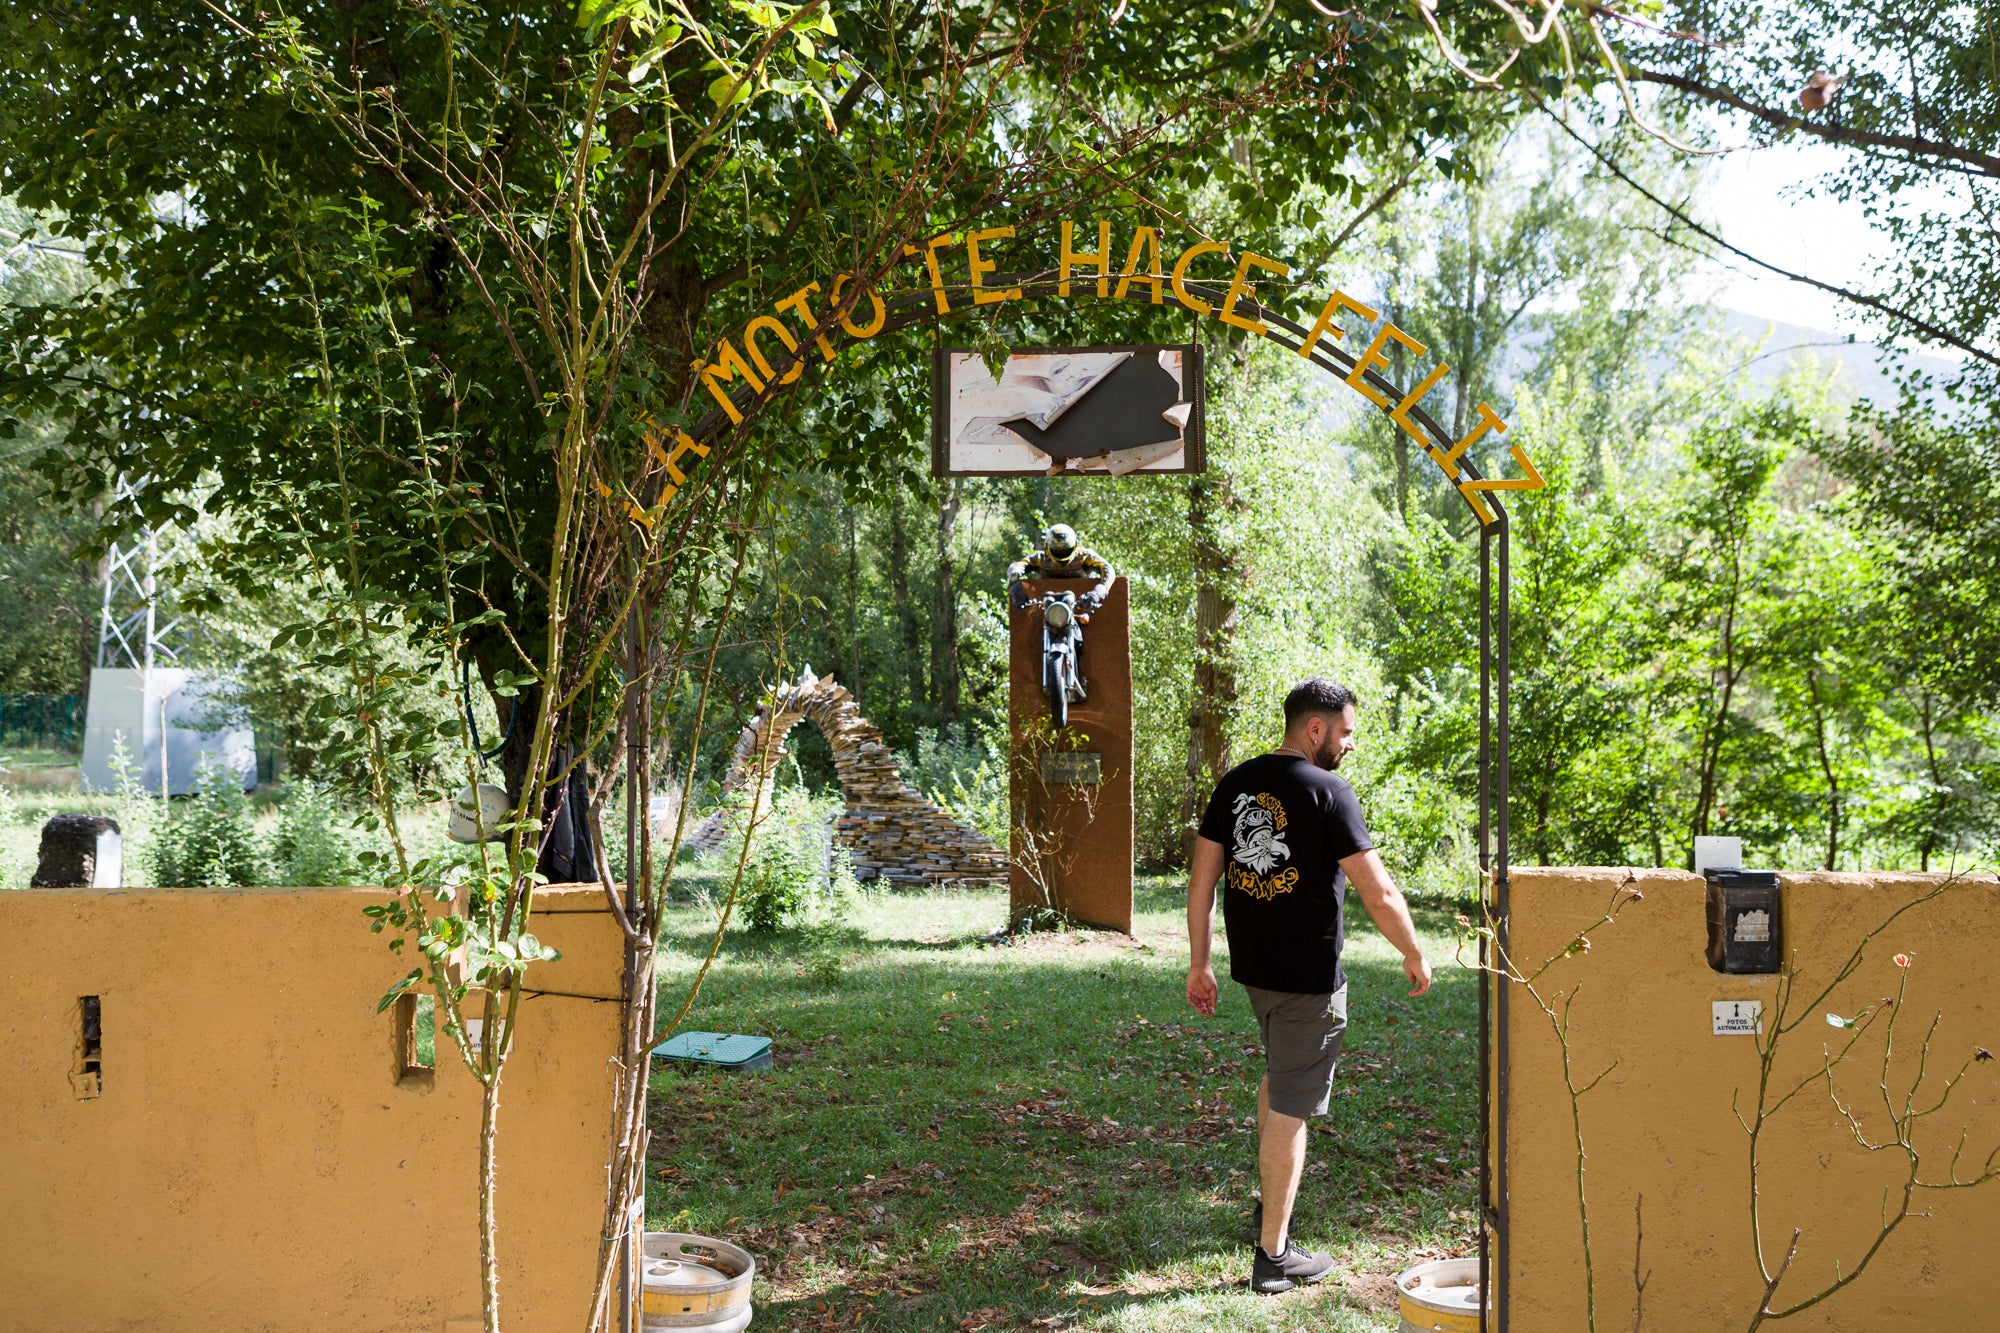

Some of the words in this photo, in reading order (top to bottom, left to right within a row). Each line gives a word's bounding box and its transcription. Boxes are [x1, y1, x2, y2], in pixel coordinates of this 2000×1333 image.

[690, 270, 886, 425] MOTO
[903, 224, 1023, 315] TE
[1058, 220, 1290, 337] HACE
[1300, 289, 1547, 527] FELIZ
